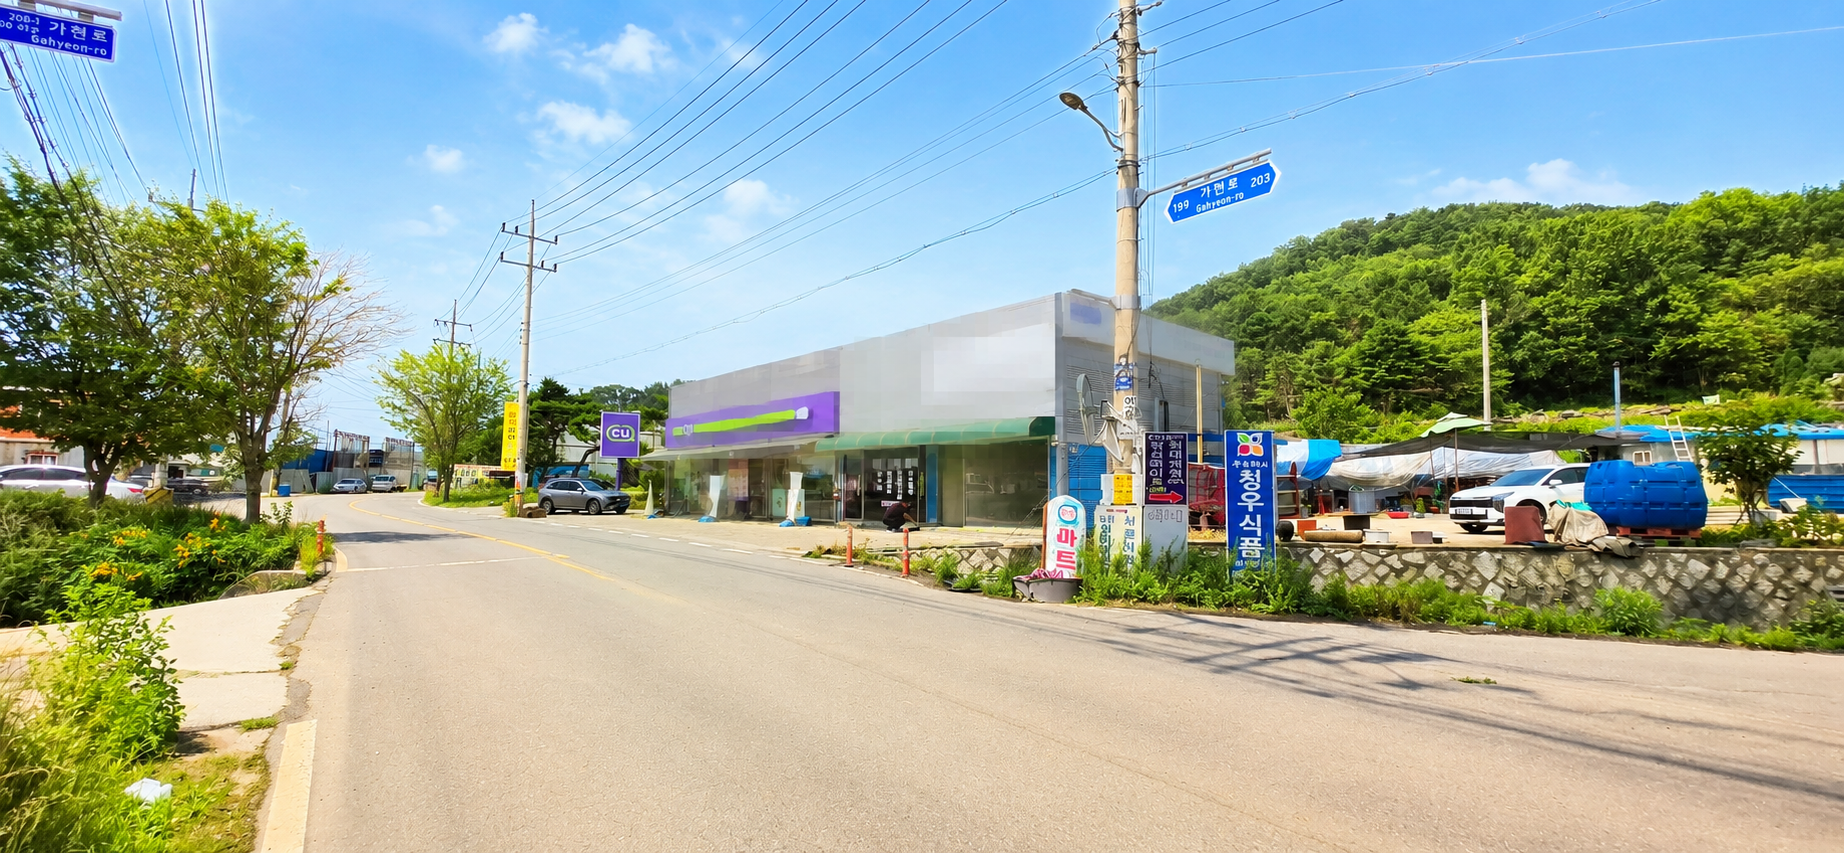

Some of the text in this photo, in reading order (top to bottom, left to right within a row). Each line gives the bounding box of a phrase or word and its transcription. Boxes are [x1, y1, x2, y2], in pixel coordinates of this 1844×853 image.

[49, 21, 108, 42] 가현로
[31, 34, 107, 56] Gahyeon-ro
[1250, 172, 1270, 188] 203
[1173, 199, 1189, 213] 199
[1056, 528, 1078, 570] 마트
